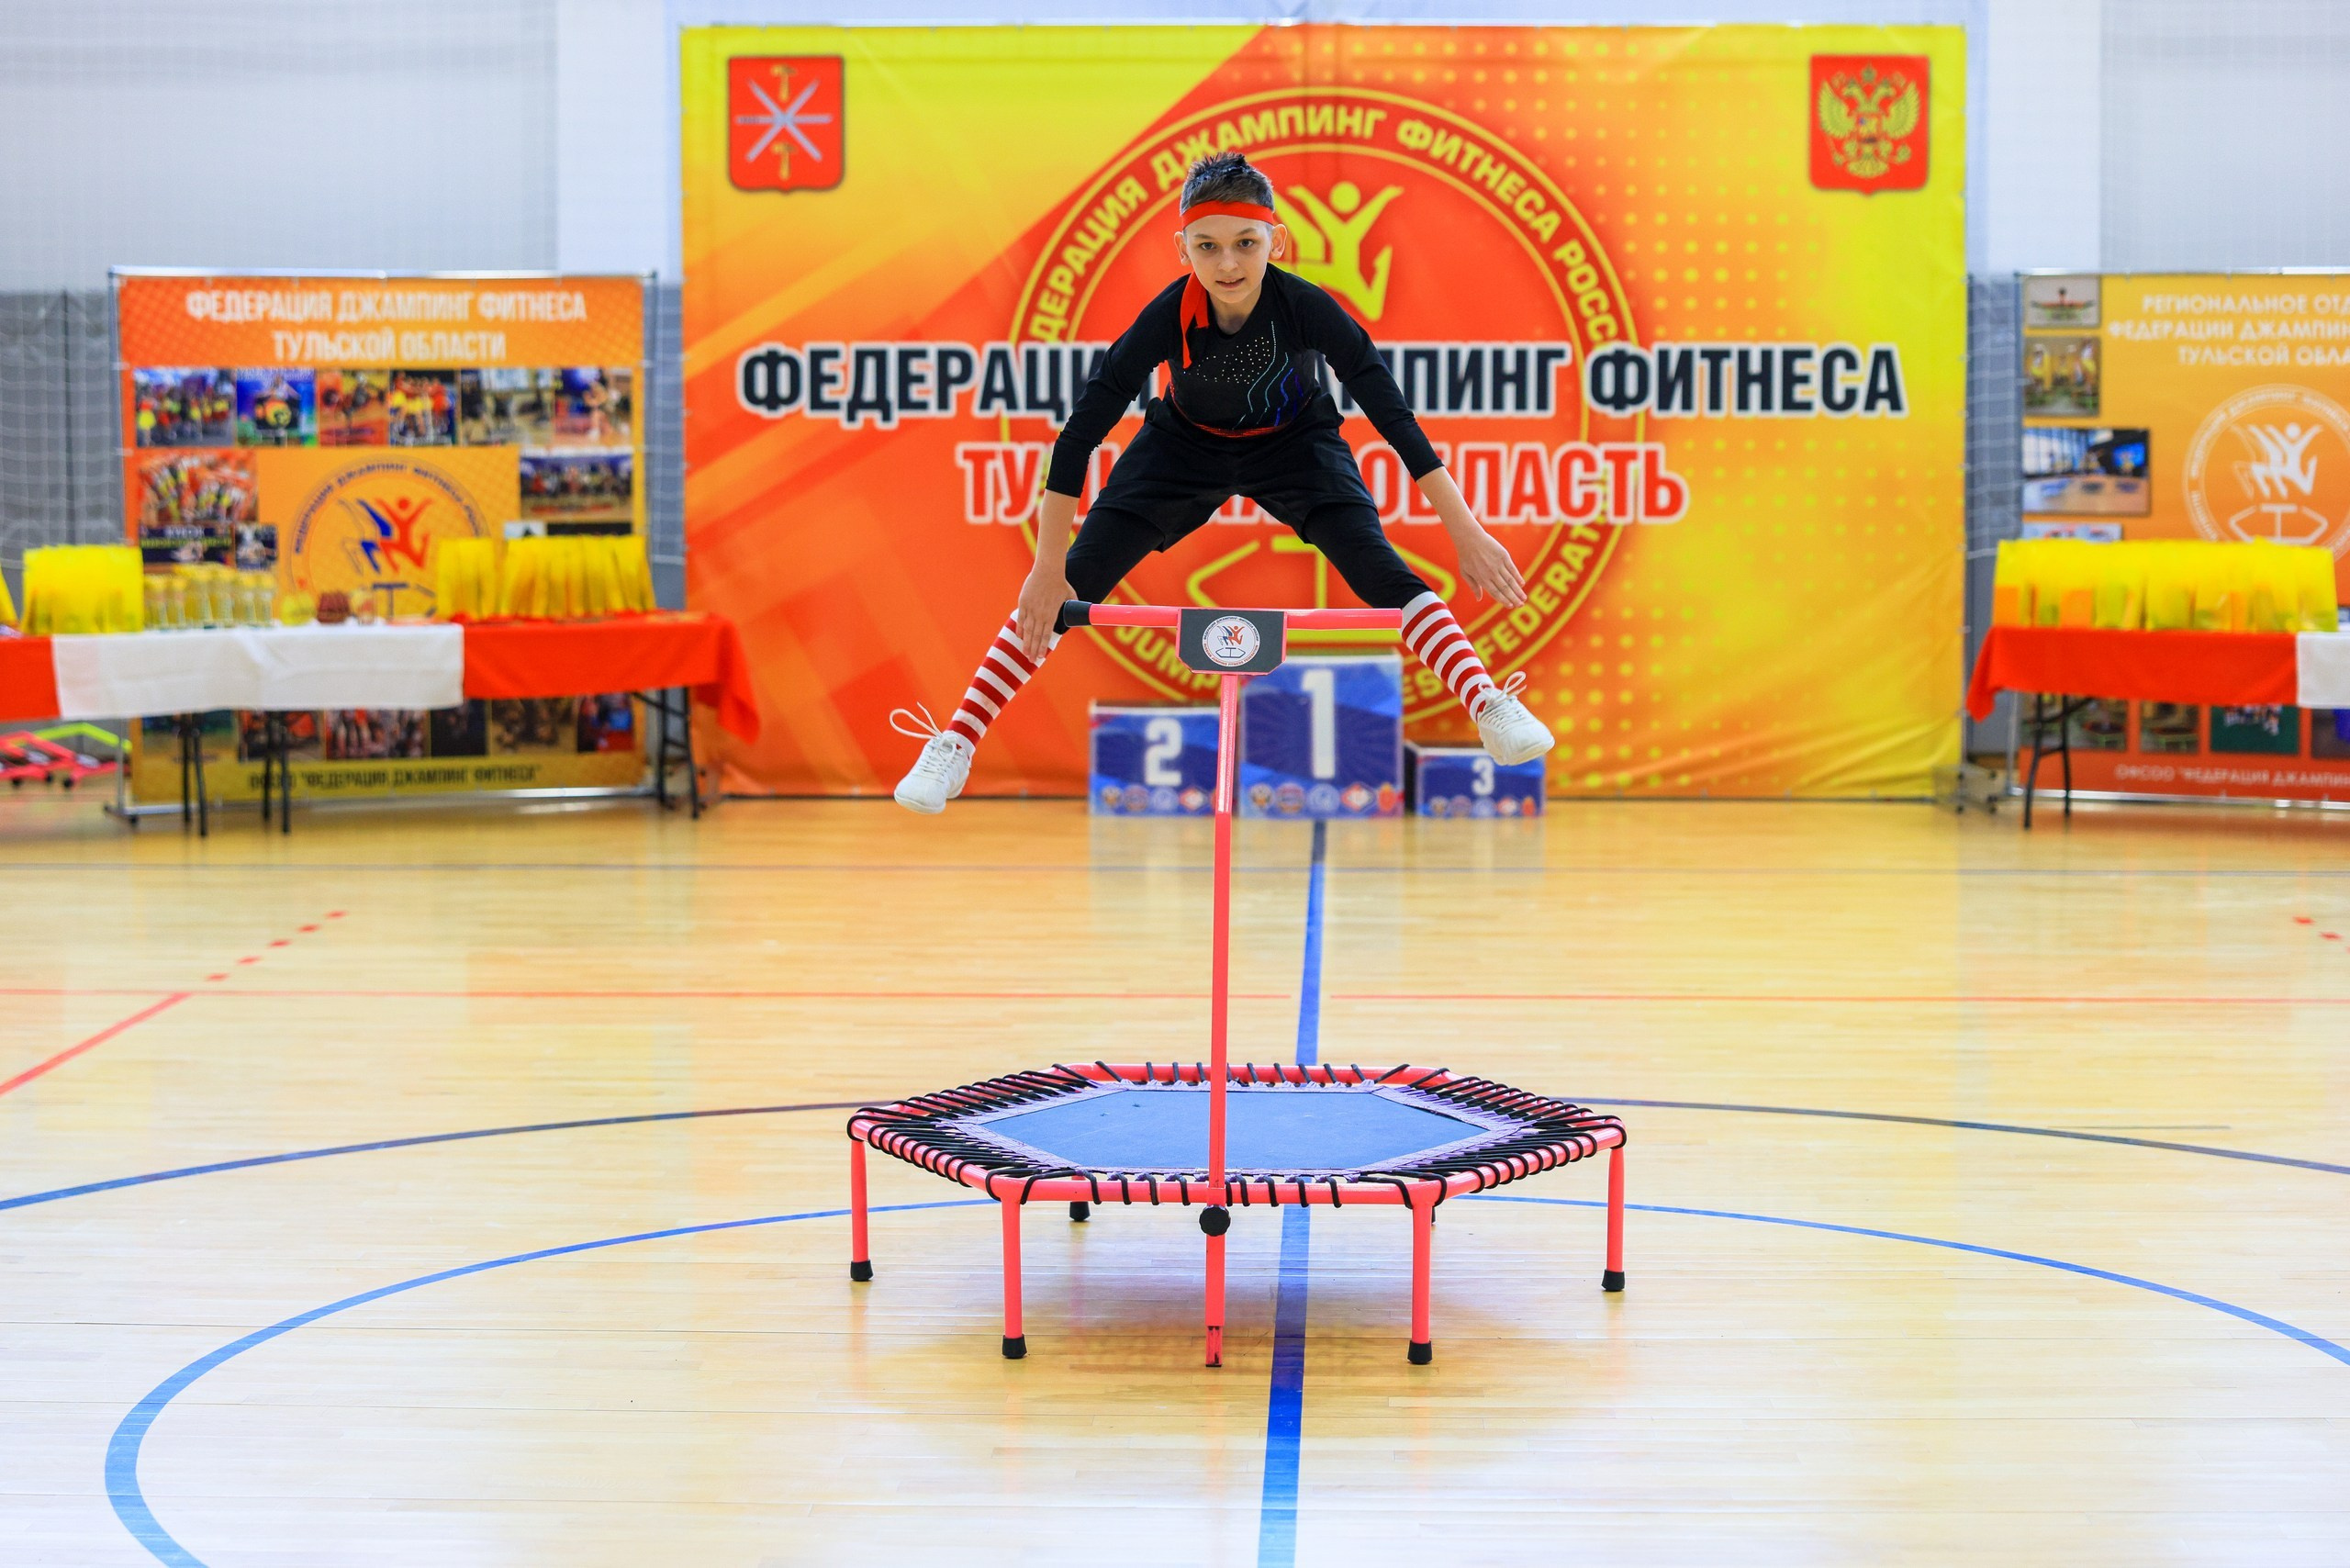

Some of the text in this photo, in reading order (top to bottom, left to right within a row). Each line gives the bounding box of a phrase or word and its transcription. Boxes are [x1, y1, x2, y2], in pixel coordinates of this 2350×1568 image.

[1028, 105, 1618, 347] ДЕРАЦИЯ ДЖАМПИНГ ФИТНЕСА РОСС
[185, 289, 588, 323] ФЕДЕРАЦИЯ ДЖАМПИНГ ФИТНЕСА
[2142, 293, 2308, 314] РЕГИОНАЛЬНОЕ
[272, 327, 507, 362] ТУЛЬСКОЙ ОБЛАСТИ
[2109, 319, 2233, 342] ФЕДЕРАЦИИ
[2178, 342, 2289, 366] ТУЛЬСКОЙ
[1589, 345, 1906, 414] ФИТНЕСА
[1473, 516, 1603, 668] FEDERAT
[1300, 668, 1337, 780] 1
[1144, 717, 1183, 787] 2
[1472, 758, 1495, 796] 3
